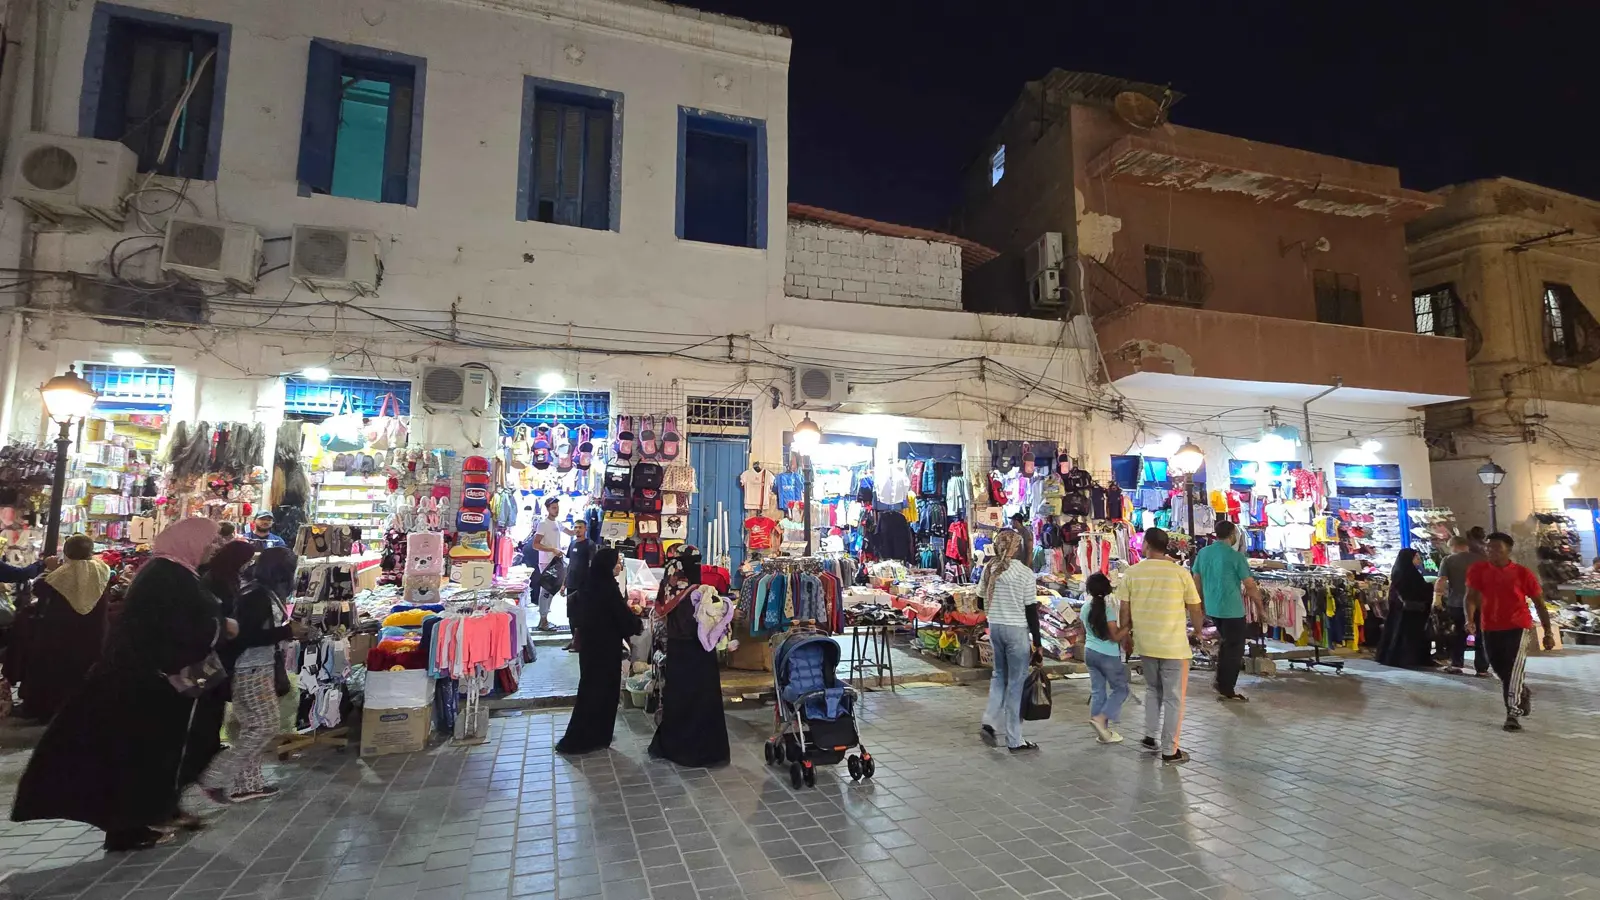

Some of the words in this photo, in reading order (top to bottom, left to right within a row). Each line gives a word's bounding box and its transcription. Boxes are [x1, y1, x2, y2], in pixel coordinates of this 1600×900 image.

[138, 521, 148, 540] 1
[609, 523, 619, 536] 5
[473, 566, 485, 587] 5
